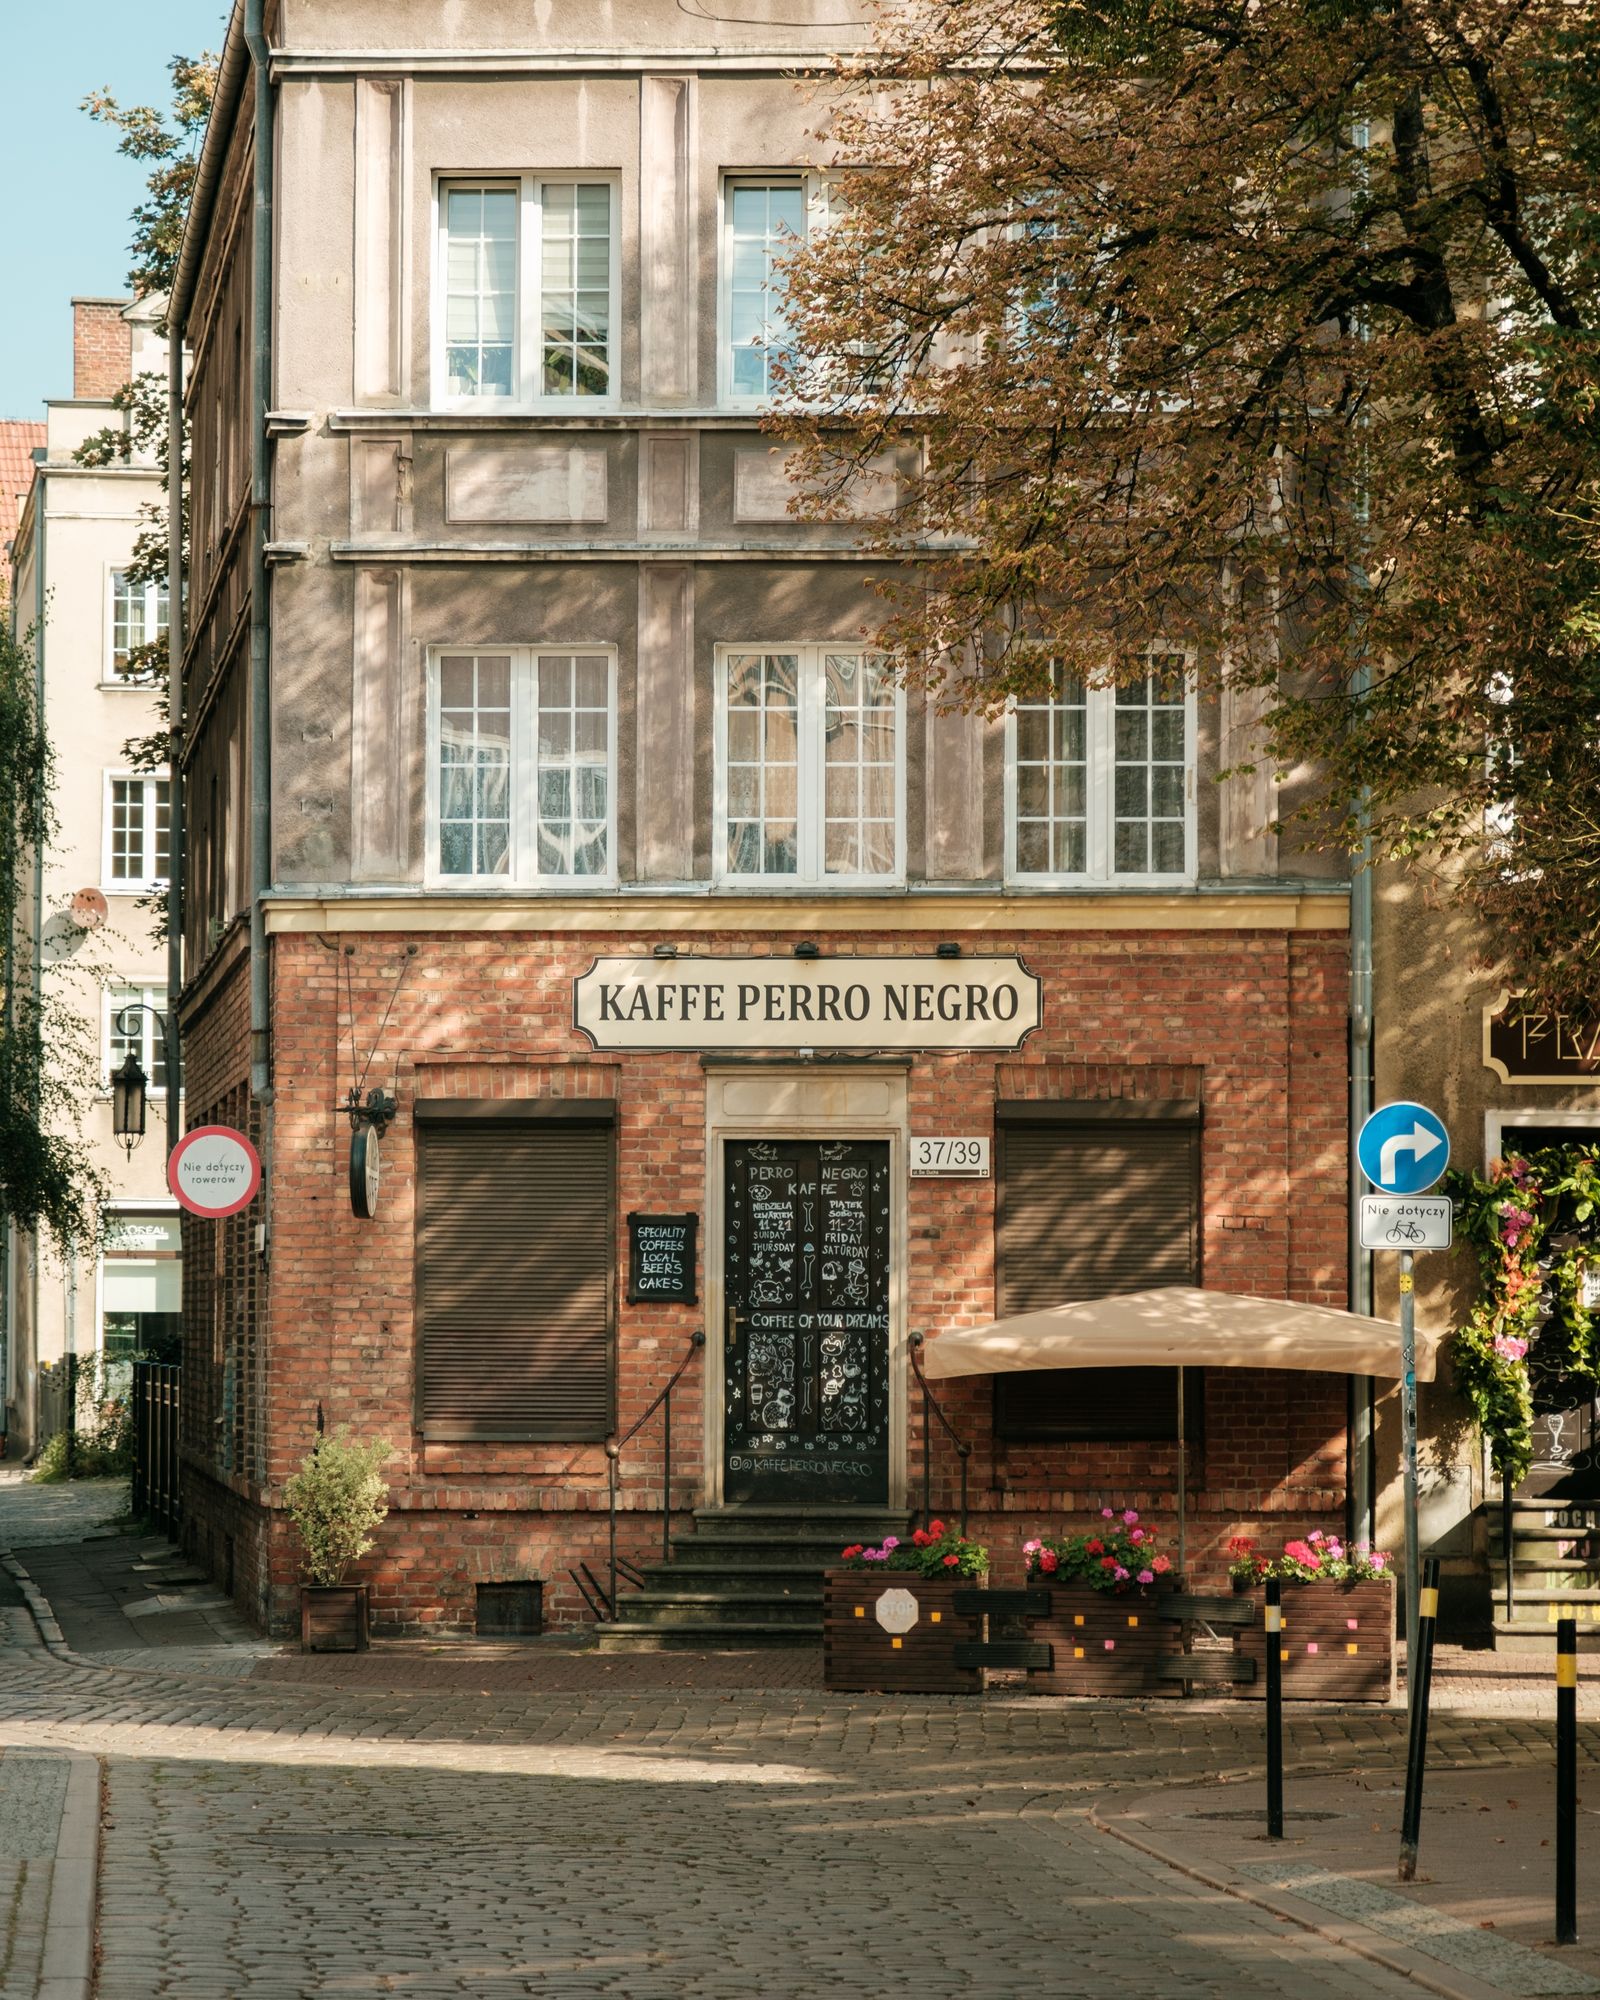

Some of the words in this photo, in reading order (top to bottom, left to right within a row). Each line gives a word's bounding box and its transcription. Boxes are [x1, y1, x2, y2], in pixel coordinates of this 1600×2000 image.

[599, 984, 724, 1021] KAFFE
[737, 984, 870, 1022] PERRO
[883, 984, 1018, 1022] NEGRO
[919, 1141, 981, 1165] 37/39
[184, 1162, 202, 1172] Nie
[206, 1162, 245, 1174] dotyczy
[750, 1167, 793, 1180] PERRO
[822, 1167, 868, 1180] NEGRO
[752, 1201, 792, 1211] NIEDZIELA
[829, 1200, 863, 1210] PIĄTEK
[828, 1210, 865, 1218] SOBOTA
[1368, 1205, 1389, 1215] Nie
[1397, 1205, 1445, 1219] dotyczy
[753, 1231, 786, 1240] SUNDAY
[825, 1233, 862, 1245] FRIDAY
[640, 1240, 684, 1251] COFFEES
[752, 1243, 795, 1252] THURSDAY
[643, 1252, 680, 1263] LOCAL
[822, 1245, 870, 1259] SATURDAY
[641, 1263, 683, 1274] BEERS
[639, 1278, 683, 1290] CAKES
[751, 1313, 795, 1328] COFFEE
[798, 1314, 814, 1327] OF
[817, 1314, 843, 1328] YOUR
[846, 1314, 889, 1329] DREAMS
